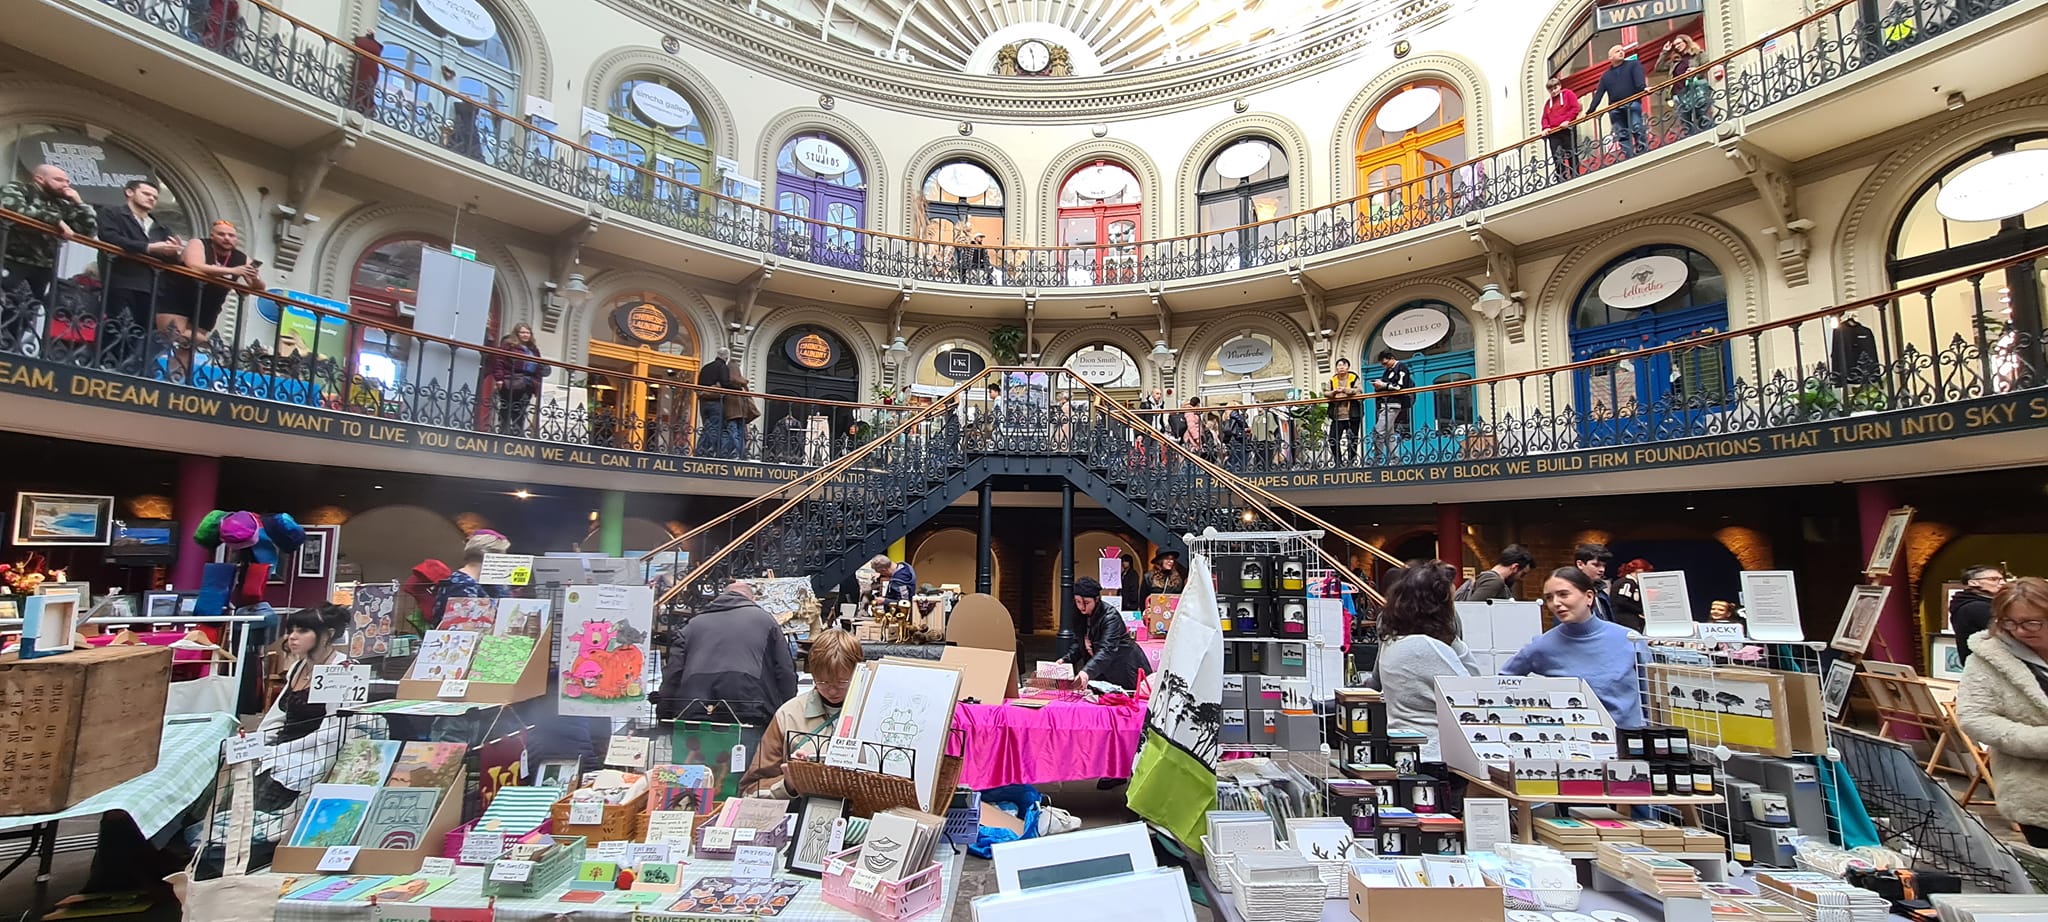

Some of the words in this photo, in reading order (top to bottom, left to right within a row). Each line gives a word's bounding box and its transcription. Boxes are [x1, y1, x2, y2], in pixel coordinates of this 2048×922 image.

[1609, 3, 1648, 24] WAY
[1653, 0, 1687, 16] OUT
[636, 90, 664, 105] simcha
[665, 101, 690, 117] gallery
[40, 141, 106, 161] LEEDS
[632, 320, 665, 332] LAUNDRY
[1388, 329, 1403, 338] ALL
[1404, 324, 1429, 335] BLUES
[1430, 322, 1442, 331] CO
[1079, 356, 1096, 364] Dion
[1096, 356, 1117, 364] Smith
[1225, 348, 1265, 360] Wardrobe
[71, 375, 160, 408] DREAM
[168, 392, 221, 416] HOW
[229, 402, 269, 424] YOU
[277, 410, 333, 433] WANT
[340, 420, 362, 437] TO
[369, 424, 409, 443] LIVE.
[417, 431, 449, 448] YOU
[455, 436, 488, 453] CAN
[493, 442, 498, 454] I
[504, 442, 535, 458] CAN
[541, 447, 564, 462] WE
[569, 452, 596, 466] ALL
[601, 453, 632, 468] CAN.
[636, 457, 649, 470] IT
[653, 459, 678, 472] ALL
[682, 461, 729, 476] STARTS
[733, 465, 763, 479] WITH
[767, 468, 799, 481] YOUR
[1293, 474, 1318, 487] OUR
[1323, 472, 1375, 485] FUTURE.
[1380, 468, 1425, 483] BLOCK
[1430, 467, 1447, 480] BY
[1453, 463, 1500, 479] BLOCK
[1506, 460, 1531, 475] WE
[1537, 456, 1583, 473] BUILD
[1589, 453, 1628, 470] FIRM
[1635, 437, 1762, 464] FOUNDATIONS
[1769, 428, 1821, 451] THAT
[1831, 419, 1892, 444] TURN
[1901, 411, 1955, 437] INTO
[1965, 402, 2018, 428] SKY
[1705, 626, 1738, 634] JACKY
[313, 674, 324, 690] 3
